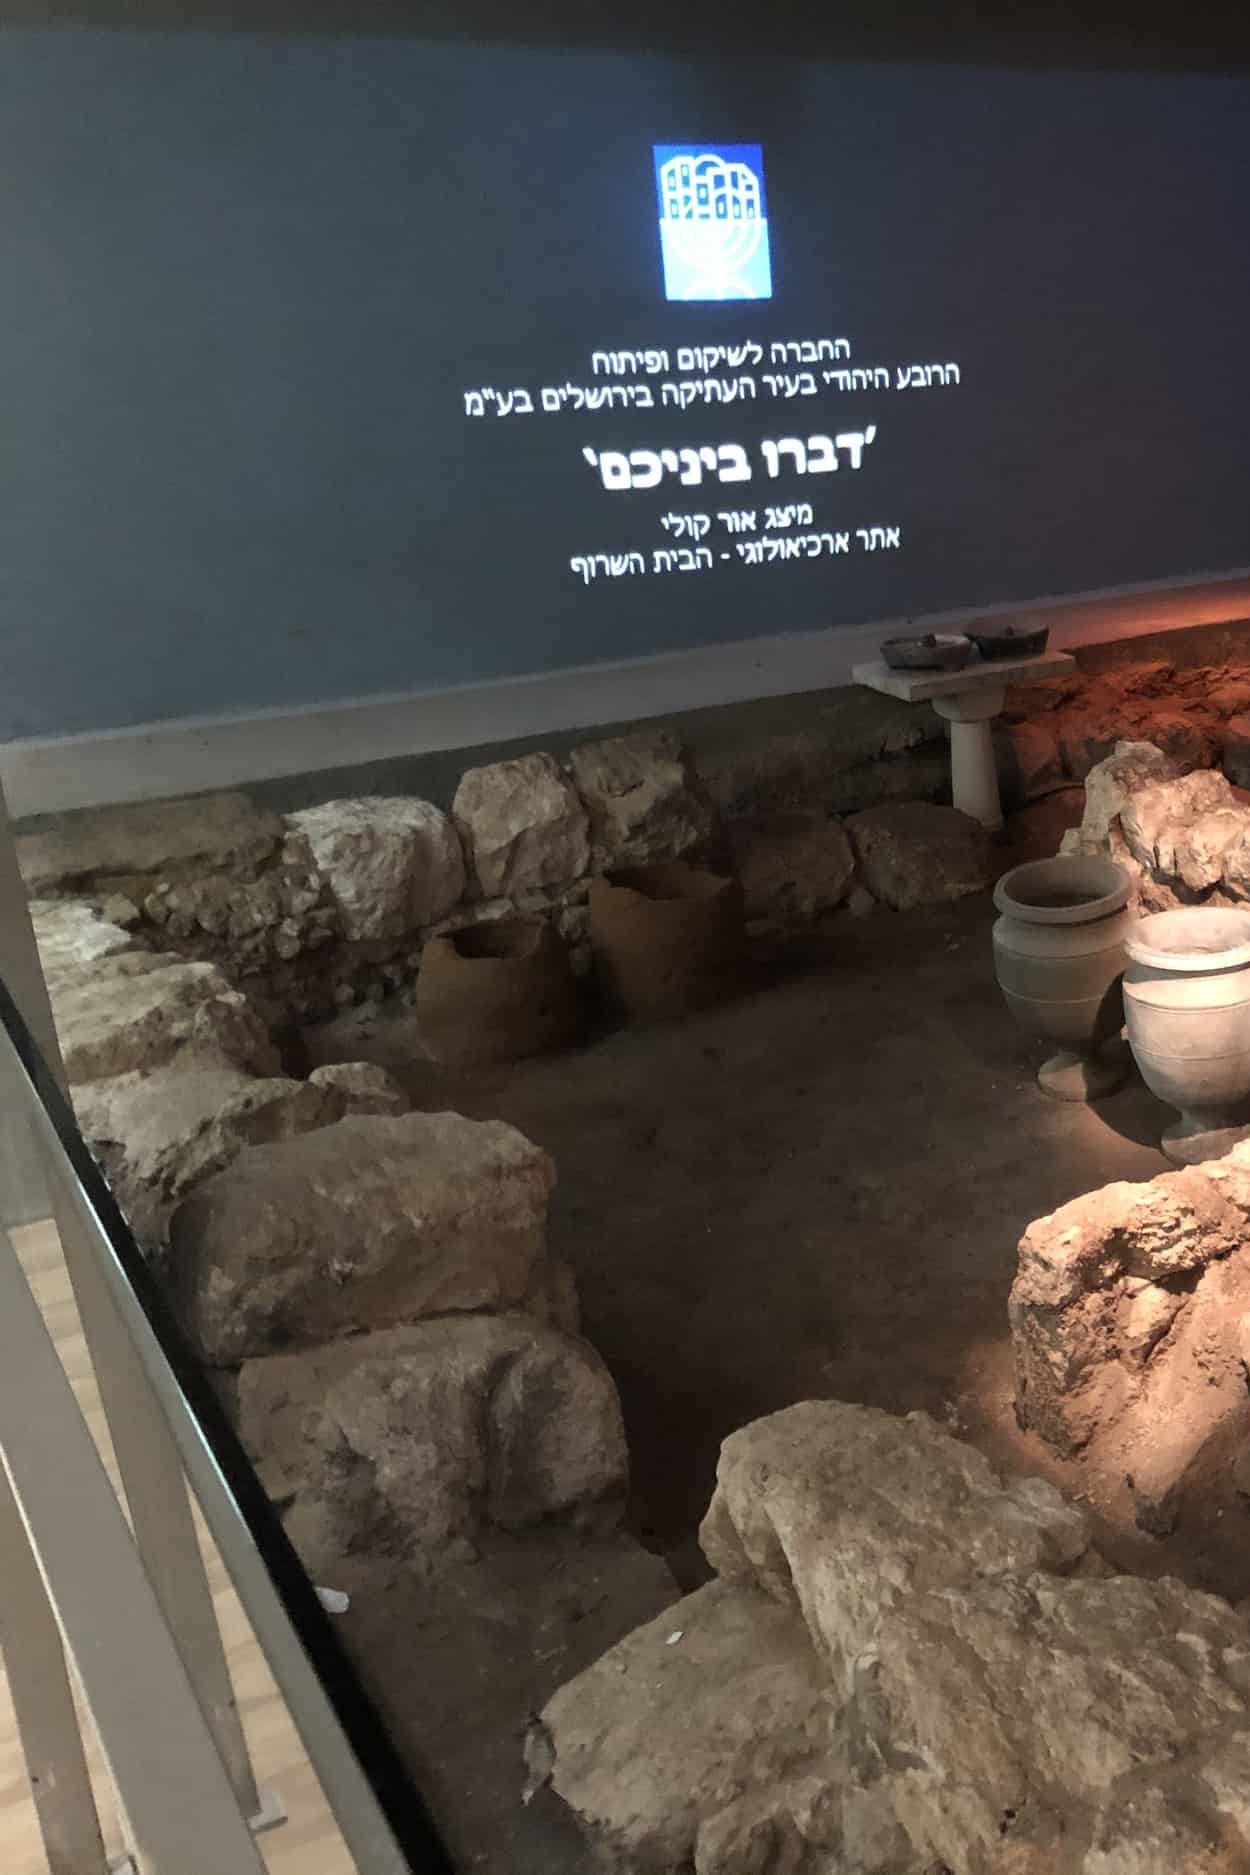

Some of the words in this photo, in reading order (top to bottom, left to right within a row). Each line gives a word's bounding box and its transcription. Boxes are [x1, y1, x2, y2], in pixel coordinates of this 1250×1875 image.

[592, 349, 670, 376] ופיתוח
[677, 340, 763, 375] לשיקום
[771, 339, 851, 364] החברה
[762, 372, 818, 398] בעיר
[823, 367, 890, 392] היהודי
[897, 362, 961, 390] הרובע
[541, 381, 655, 412] בירושלים
[661, 376, 757, 410] העתיקה
[661, 511, 711, 542] קולי
[716, 510, 757, 533] אור
[764, 503, 814, 530] מיצג
[735, 531, 850, 565] ארכיאולוגי
[855, 527, 900, 551] אתר
[570, 552, 646, 585] השרוף
[652, 546, 713, 574] הבית
